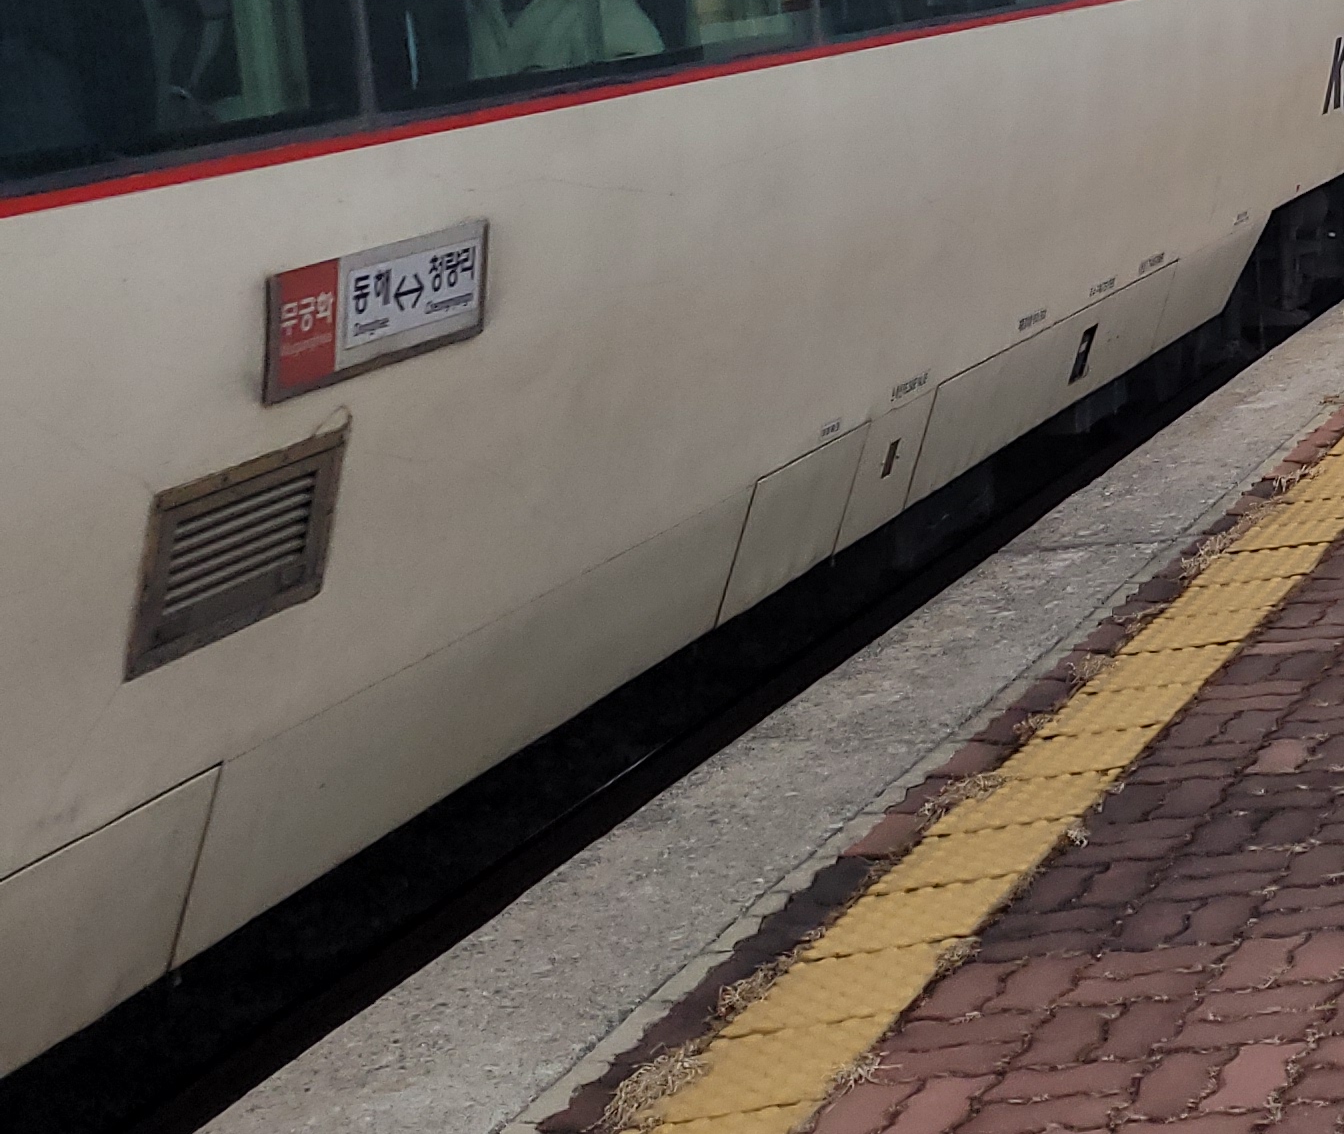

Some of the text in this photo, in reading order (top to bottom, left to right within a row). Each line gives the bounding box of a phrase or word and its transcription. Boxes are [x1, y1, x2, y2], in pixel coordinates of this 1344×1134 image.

[353, 268, 392, 314] 동해
[428, 246, 477, 292] 청량리
[280, 291, 334, 336] 무궁화
